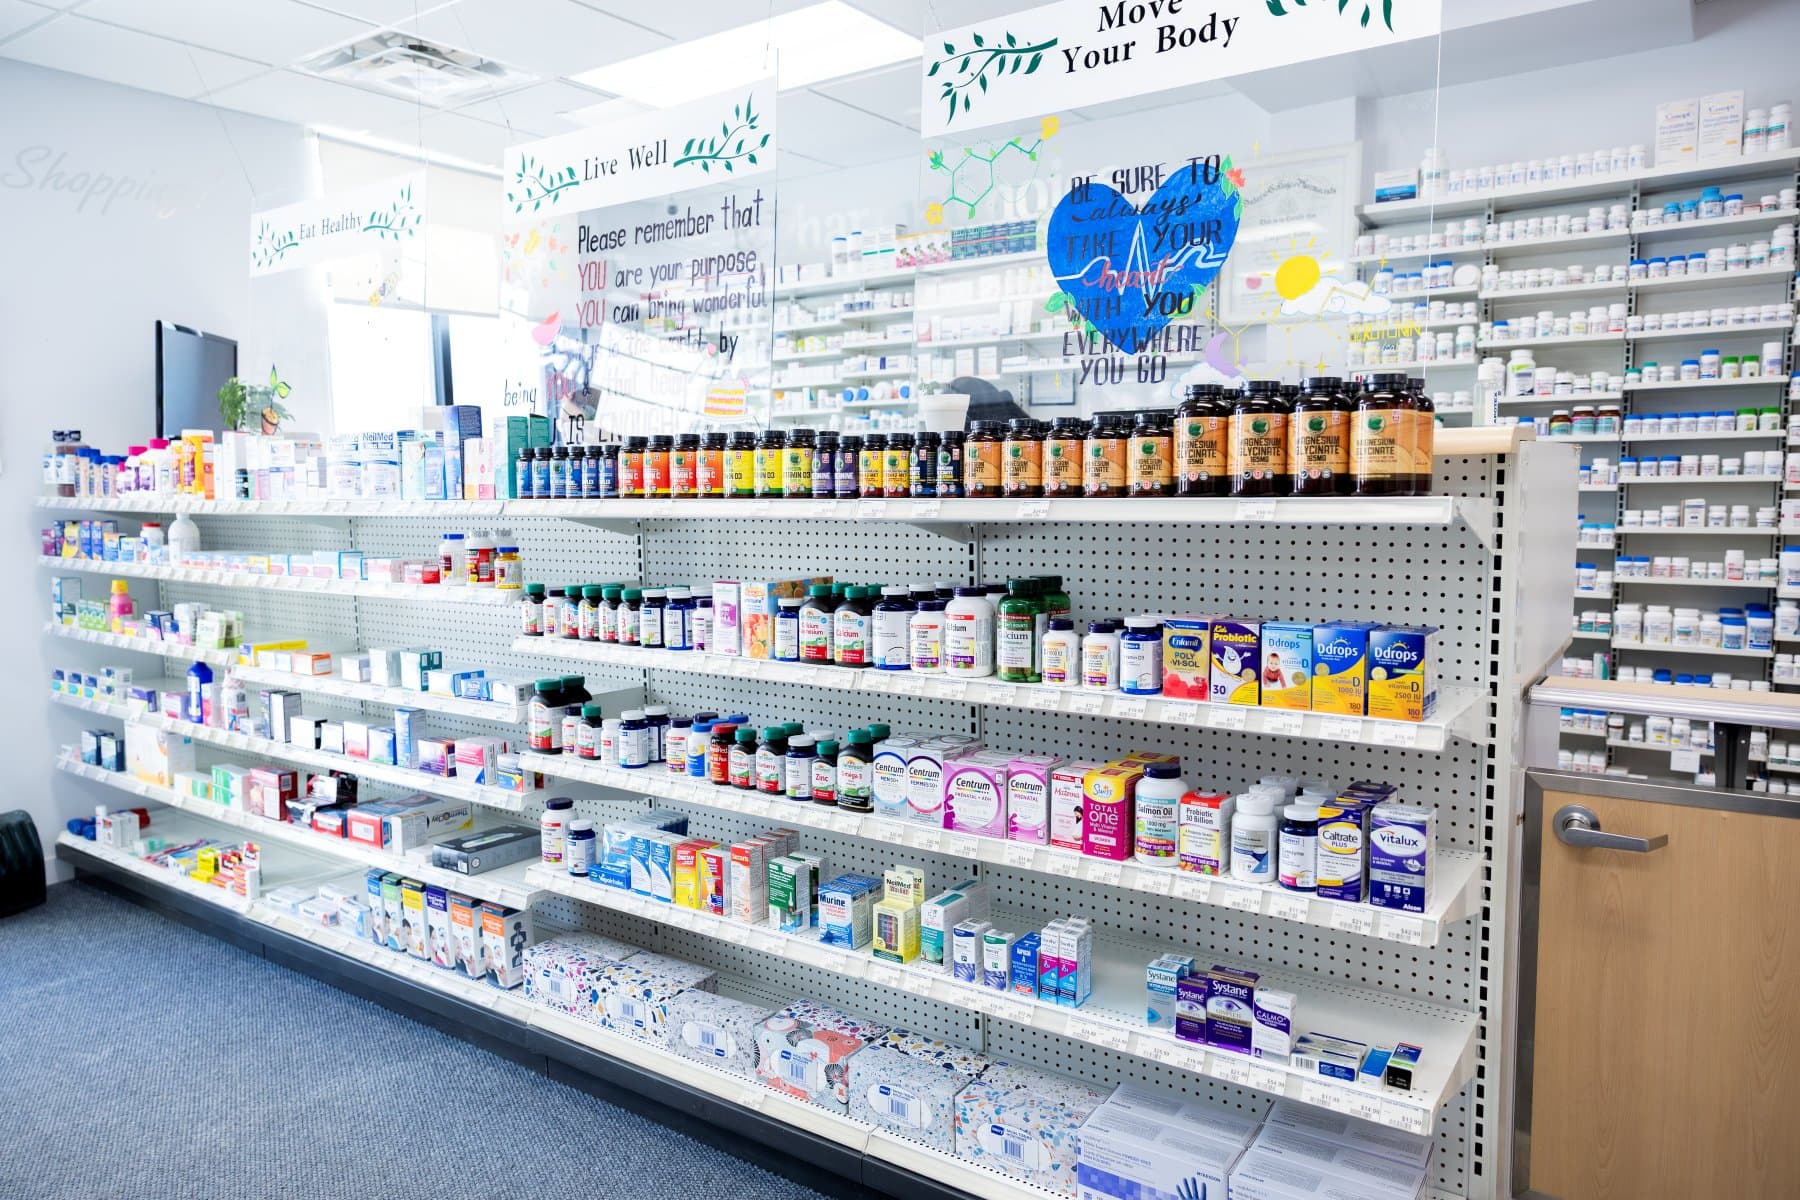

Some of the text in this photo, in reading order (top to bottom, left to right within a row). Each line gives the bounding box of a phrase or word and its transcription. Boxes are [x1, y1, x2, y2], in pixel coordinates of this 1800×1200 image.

[1097, 0, 1183, 32] Move
[1062, 12, 1240, 73] Your Body
[583, 139, 668, 182] Live Well
[1070, 174, 1098, 205] BE
[1111, 162, 1169, 197] SURE
[1185, 154, 1220, 186] TO
[299, 212, 363, 240] Eat Healthy
[578, 189, 764, 254] Please remember that
[1065, 219, 1222, 263] TAKE YOUR
[577, 249, 757, 292] YOU are your purpose
[1082, 253, 1184, 293] heart
[576, 276, 767, 330] YOU can bring wonderful
[1063, 291, 1195, 322] WITH YOU
[719, 321, 738, 360] by
[1062, 324, 1207, 357] EVERYWHERE
[1079, 354, 1167, 386] YOU GO
[504, 380, 537, 411] being
[566, 413, 585, 445] IS
[1213, 633, 1257, 643] Probiotic
[1174, 651, 1195, 660] POLY
[1317, 643, 1358, 658] Ddrops
[1374, 647, 1418, 663] Ddrops
[1352, 676, 1360, 687] D
[1411, 681, 1420, 692] D
[1213, 685, 1226, 695] 30
[1408, 708, 1420, 716] 180
[875, 763, 905, 775] Centrum
[909, 766, 940, 779] Centrum
[815, 773, 829, 782] Zinc
[956, 777, 991, 791] Centrum
[1010, 779, 1043, 792] Centrum
[1089, 803, 1119, 813] TOTAL
[1137, 803, 1173, 816] Salmon Oil
[1186, 808, 1214, 818] Probiotic
[1089, 811, 1119, 825] one
[1193, 816, 1214, 825] Billion
[1322, 830, 1359, 844] Caltrate
[886, 878, 912, 890] NeilMed
[819, 894, 846, 907] Murine
[1147, 969, 1176, 984] Systane
[1178, 987, 1205, 1001] Systane
[1212, 980, 1248, 997] Systane
[1256, 1010, 1284, 1022] CALMO
